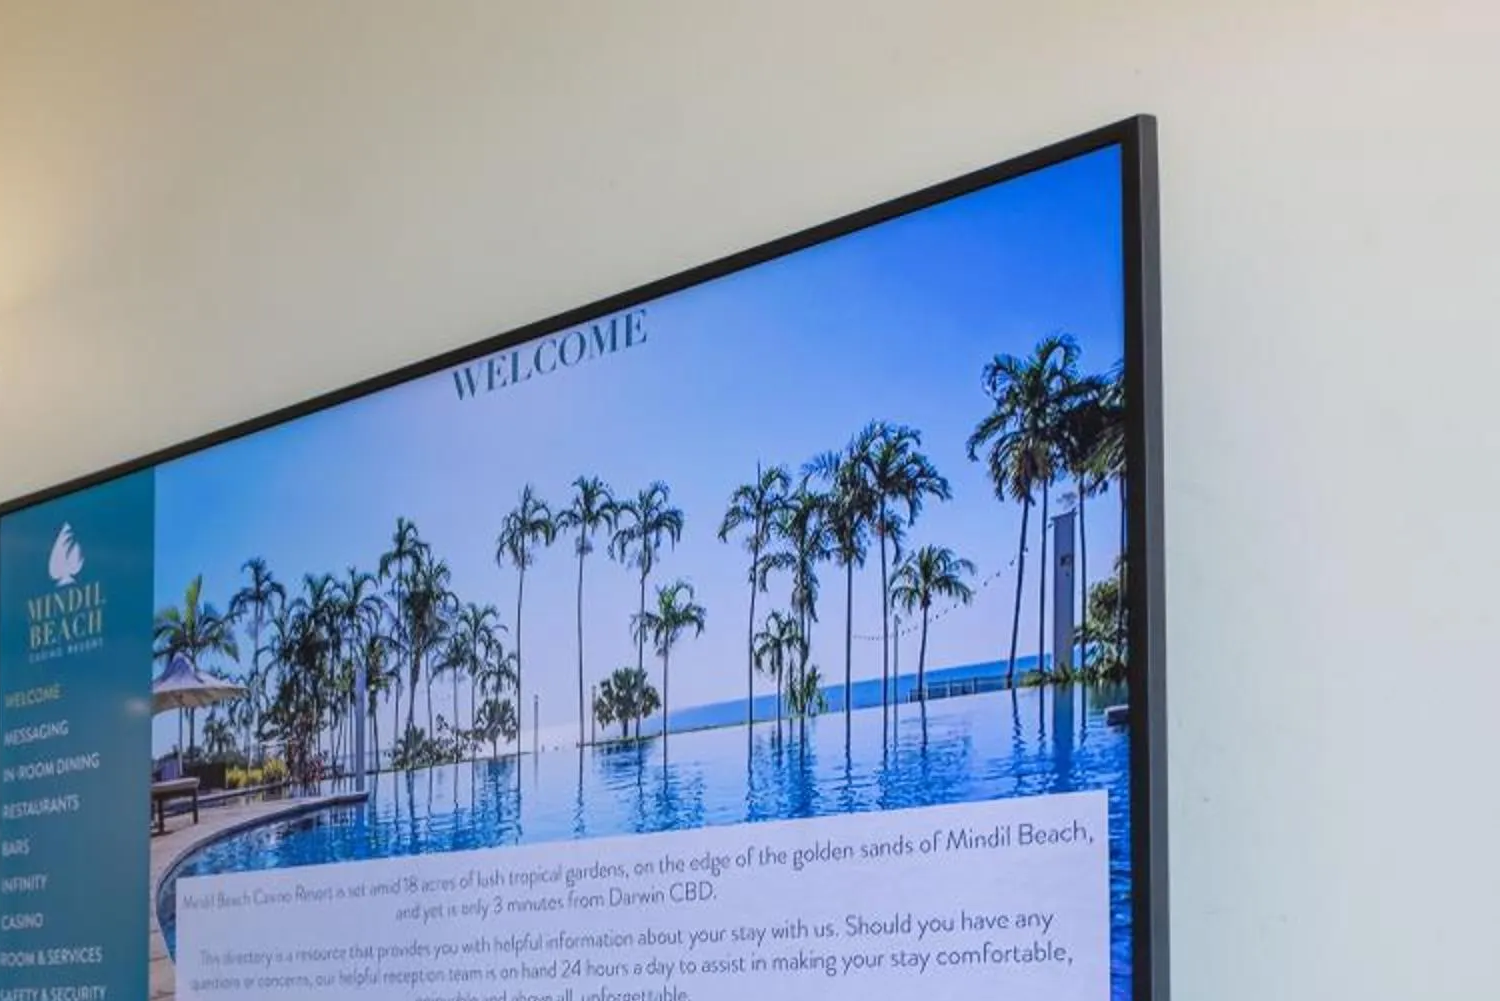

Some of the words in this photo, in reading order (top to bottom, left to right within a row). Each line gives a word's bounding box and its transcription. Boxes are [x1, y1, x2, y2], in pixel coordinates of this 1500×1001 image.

[452, 308, 648, 401] WELCOME
[28, 581, 106, 620] MINDIL
[29, 609, 102, 649] BEACH
[5, 683, 61, 708] WELCOME
[4, 719, 69, 747] MESSAGING
[56, 752, 100, 775] DINING
[2, 794, 80, 818] RESTAURANTS
[2, 839, 30, 857] BARS
[372, 879, 401, 897] amid
[403, 875, 420, 894] 18
[422, 878, 456, 893] acres
[459, 870, 475, 890] of
[477, 869, 506, 888] lush
[509, 864, 563, 889] tropical
[565, 861, 629, 887] gardens,
[633, 865, 654, 877] on
[658, 855, 685, 875] the
[689, 852, 731, 877] edge
[735, 846, 756, 868] of
[758, 846, 788, 866] the
[792, 841, 854, 871] golden
[860, 834, 914, 859] sands
[919, 830, 943, 854] of
[946, 825, 1011, 851] Mindil
[1018, 819, 1095, 846] Beach,
[2, 874, 48, 894] INFINITY
[395, 903, 420, 921] and
[422, 903, 444, 925] yet
[447, 903, 458, 917] is
[461, 899, 489, 921] only
[493, 896, 504, 915] 3
[507, 897, 565, 914] minutes
[567, 889, 605, 909] from
[609, 886, 666, 907] Darwin
[669, 880, 718, 903] CBD.
[1, 912, 44, 930] CASINO
[295, 947, 347, 963] resource
[349, 941, 375, 959] that
[377, 938, 432, 963] provides
[433, 943, 459, 960] you
[462, 935, 491, 954] with
[494, 931, 543, 958] helpful
[545, 929, 634, 951] information
[637, 928, 684, 947] about
[689, 928, 728, 951] your
[731, 925, 767, 948] stay
[771, 918, 809, 939] with
[813, 925, 840, 938] us.
[845, 911, 911, 937] Should
[917, 916, 955, 940] you
[961, 908, 1010, 931] have
[1015, 911, 1055, 934] any
[0, 951, 36, 967] ROOM
[38, 949, 46, 965] &
[47, 946, 103, 966] SERVICES
[257, 974, 313, 991] concerns,
[315, 973, 335, 986] our
[338, 966, 378, 989] helpful
[382, 965, 445, 990] reception
[448, 964, 482, 982] team
[486, 964, 497, 980] is
[500, 966, 519, 980] on
[521, 960, 557, 980] hand
[561, 959, 582, 979] 24
[585, 955, 628, 977] hours
[633, 963, 643, 976] a
[645, 956, 675, 981] day
[679, 957, 697, 975] to
[701, 955, 746, 974] assist
[751, 951, 767, 972] in
[772, 950, 837, 977] making
[841, 953, 885, 976] your
[891, 949, 931, 975] stay
[935, 940, 1074, 967] comfortable,
